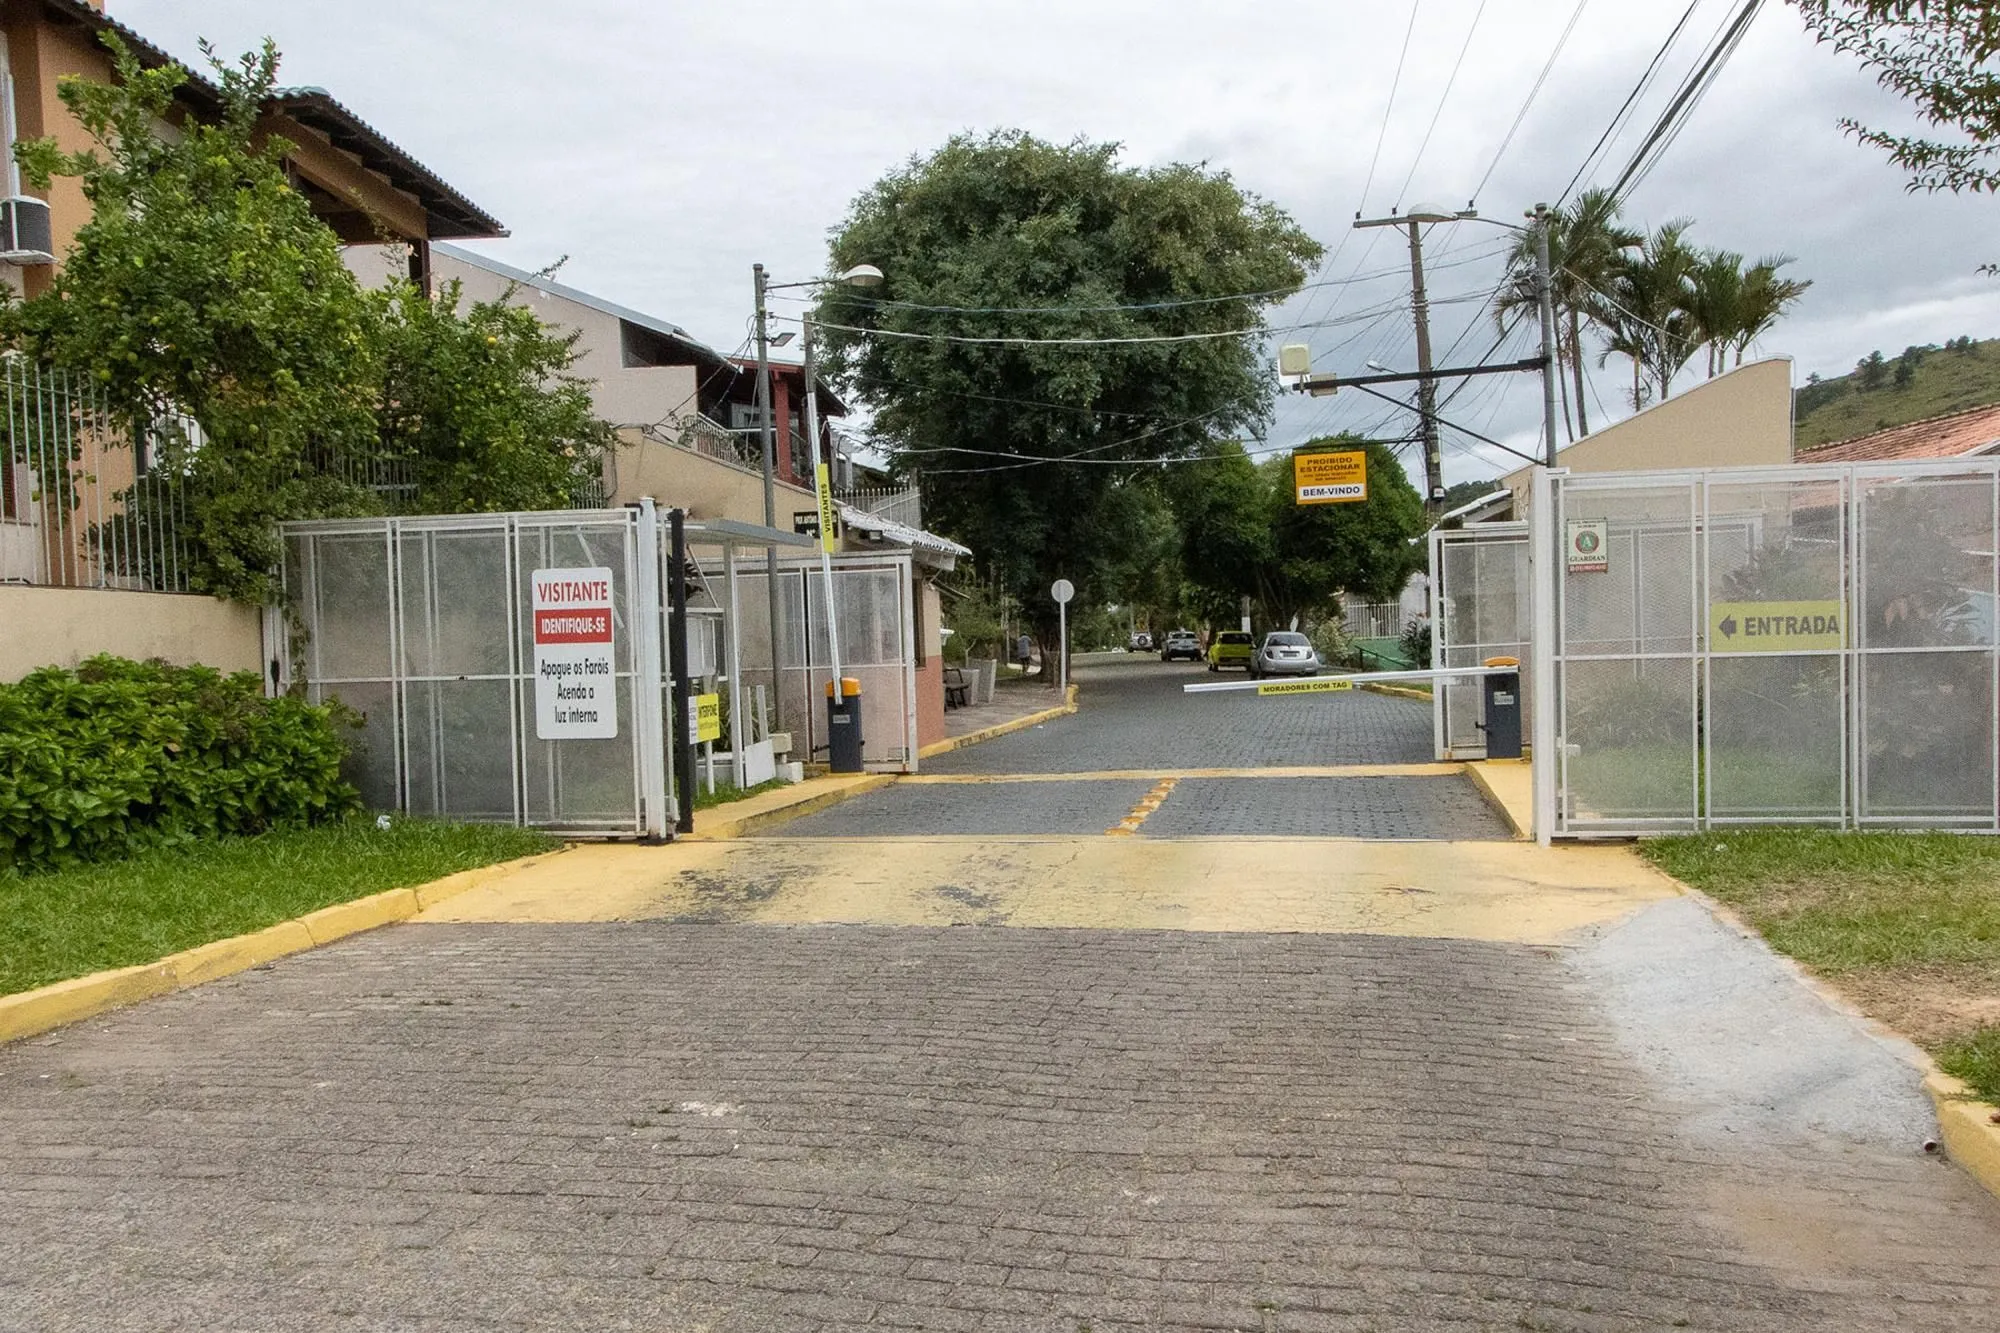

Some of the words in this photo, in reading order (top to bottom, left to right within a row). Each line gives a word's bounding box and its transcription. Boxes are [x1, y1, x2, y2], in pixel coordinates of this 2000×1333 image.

[1300, 463, 1361, 473] ESTACIONAR
[1307, 457, 1353, 465] PROIBIDO
[1303, 486, 1360, 497] BEM-VINDO
[821, 483, 832, 533] VISITANTES
[538, 581, 608, 602] VISITANTE
[541, 617, 606, 635] IDENTIFIQUE-SE
[1744, 615, 1841, 636] ENTRADA
[541, 659, 572, 680] Apague
[573, 665, 583, 676] os
[557, 682, 587, 700] Acenda
[588, 688, 595, 700] a
[1263, 684, 1311, 693] MORADORES
[1332, 681, 1348, 689] TAG
[555, 706, 567, 723] luz
[568, 706, 598, 723] interna
